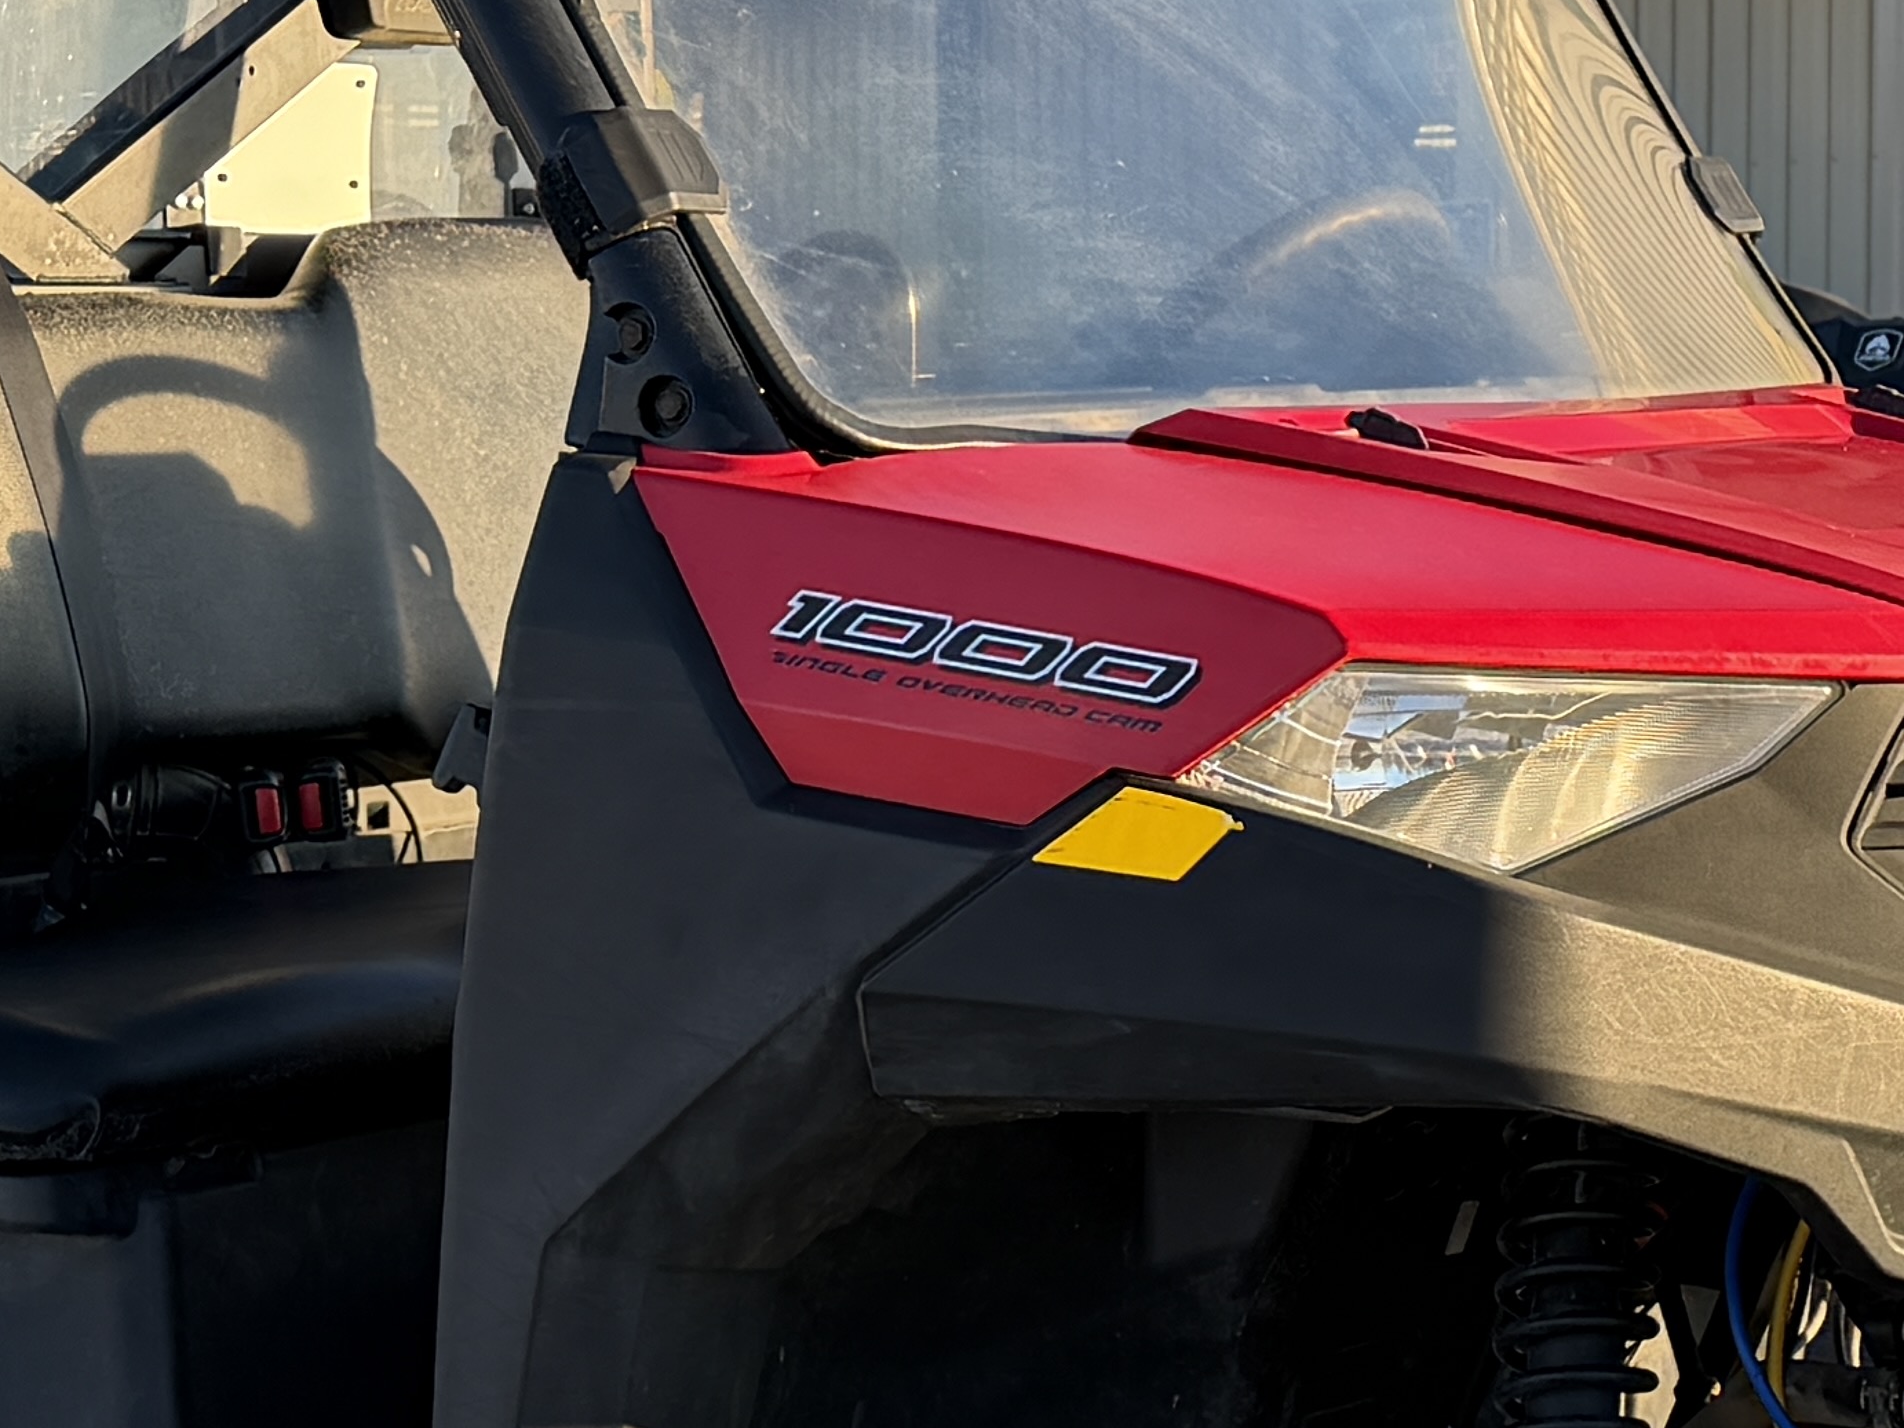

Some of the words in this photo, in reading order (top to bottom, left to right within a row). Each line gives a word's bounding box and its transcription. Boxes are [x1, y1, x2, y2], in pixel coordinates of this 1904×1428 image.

[769, 589, 1202, 710] 1000
[771, 649, 887, 683] SINGLE
[897, 675, 1079, 717] OVERHEAD
[1084, 704, 1164, 733] CAM
